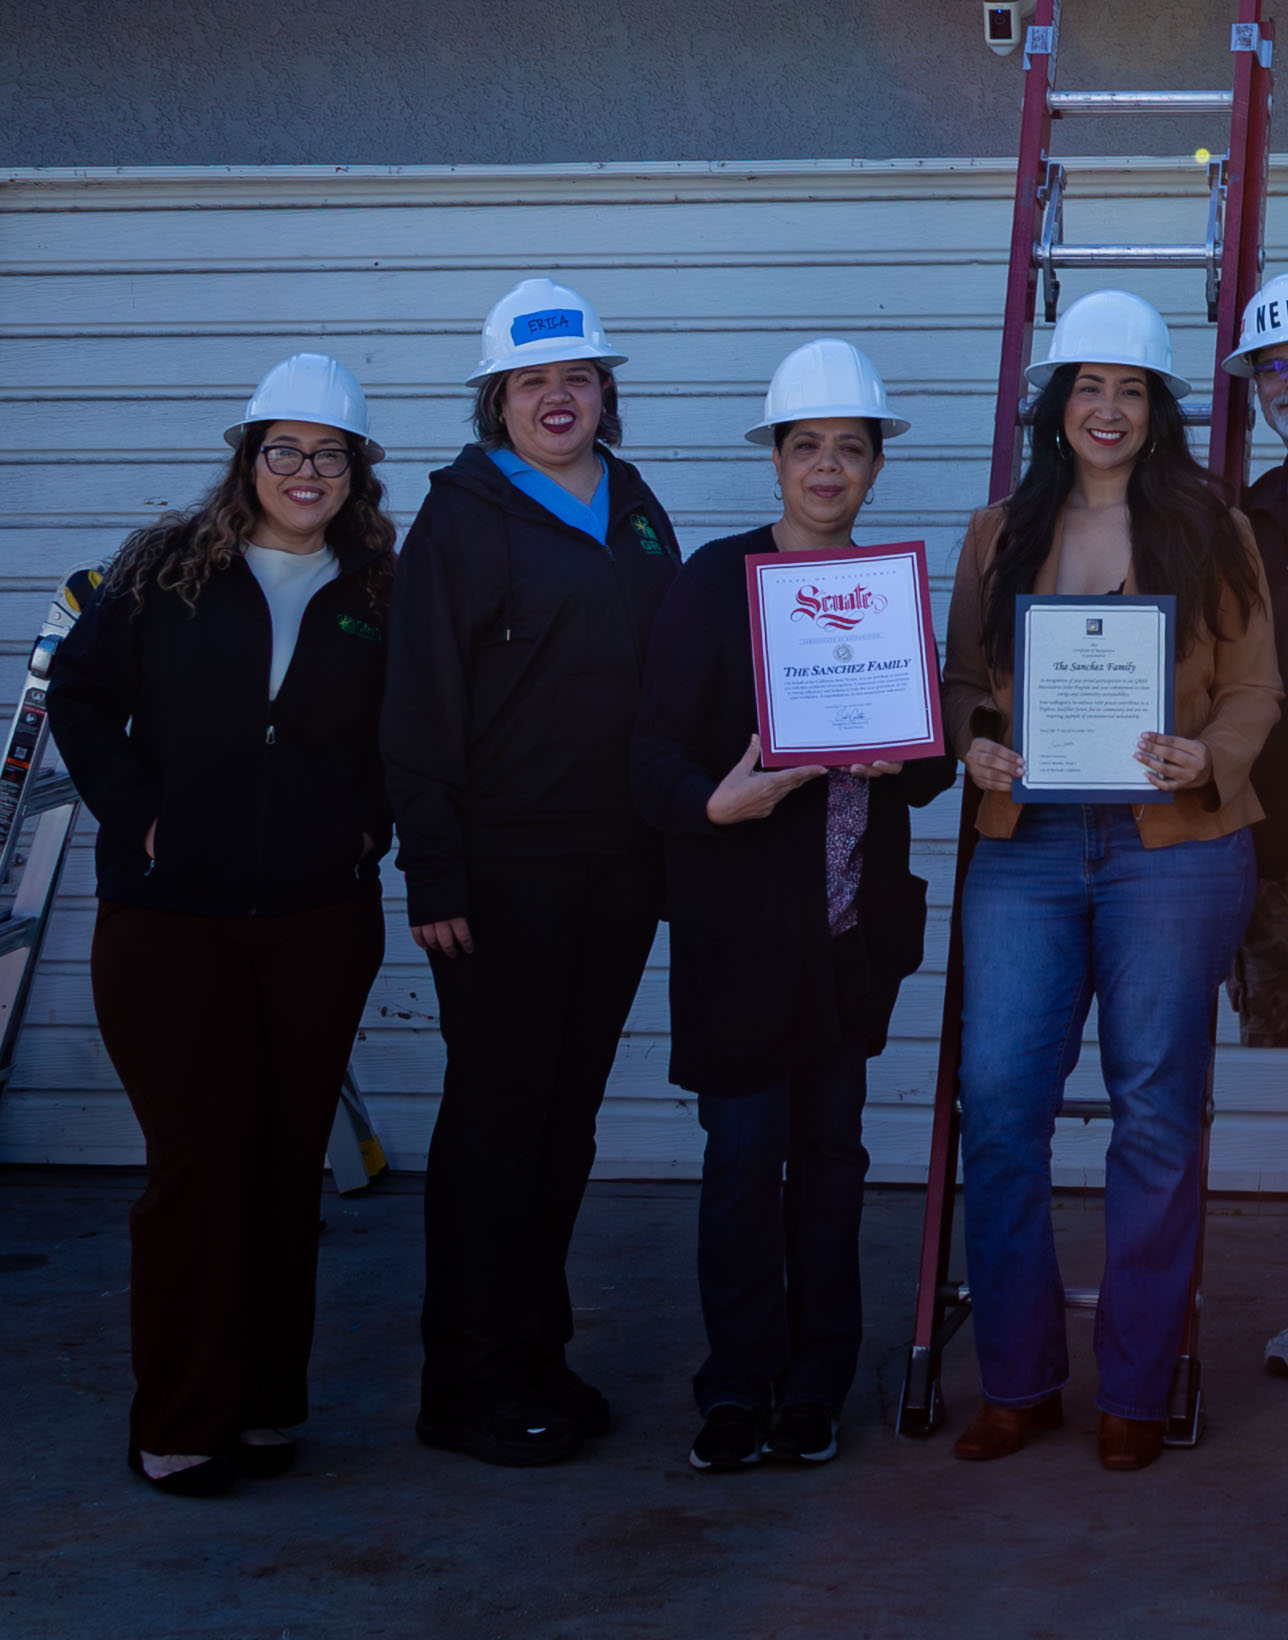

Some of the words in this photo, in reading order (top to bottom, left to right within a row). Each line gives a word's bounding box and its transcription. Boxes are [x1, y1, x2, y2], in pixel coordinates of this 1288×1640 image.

[528, 315, 569, 333] ERICA
[784, 666, 809, 678] THE
[810, 663, 865, 676] SANCHEZ
[867, 658, 911, 672] FAMILY
[1053, 661, 1069, 672] The
[1069, 661, 1105, 672] Sanchez
[1106, 661, 1136, 674] Family
